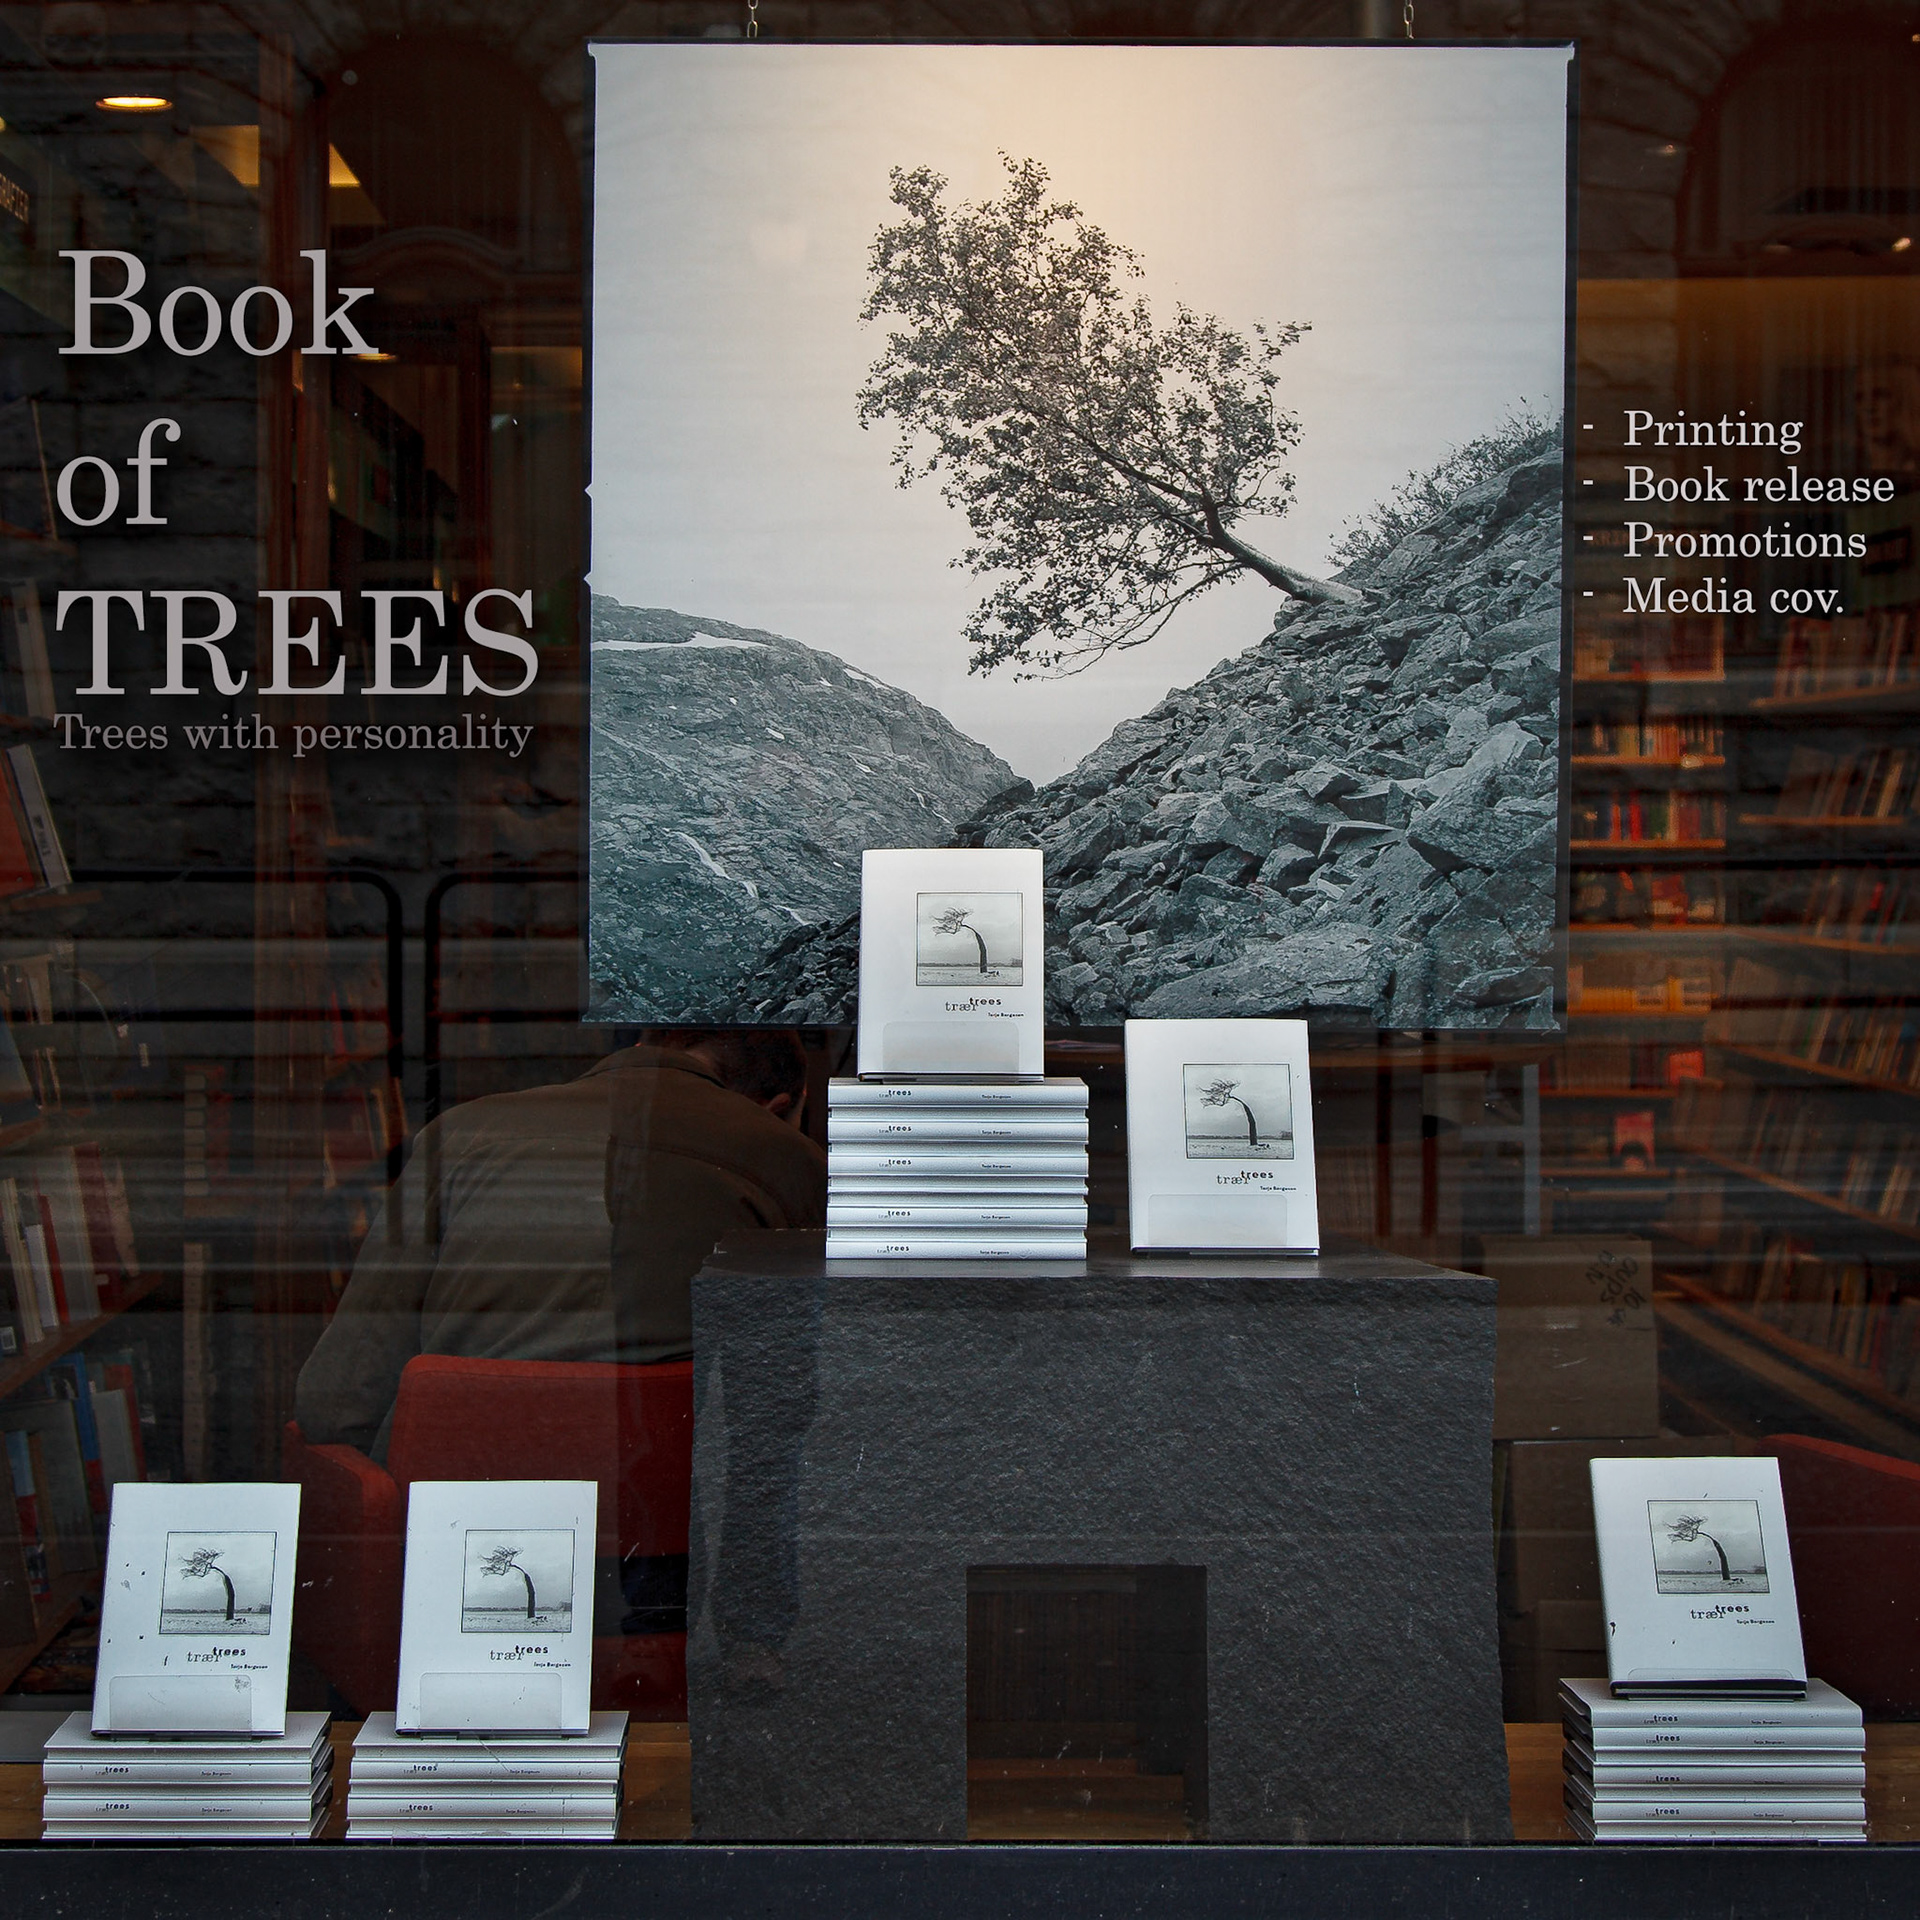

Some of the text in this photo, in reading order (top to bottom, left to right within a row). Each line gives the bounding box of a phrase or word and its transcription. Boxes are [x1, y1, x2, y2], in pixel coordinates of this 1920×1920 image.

[969, 997, 1002, 1007] trees
[888, 1089, 912, 1097] trees
[1241, 1170, 1274, 1180] trees
[1715, 1604, 1750, 1615] trees
[212, 1646, 247, 1657] trees
[515, 1645, 549, 1655] trees
[1654, 1714, 1679, 1722] trees
[1656, 1733, 1680, 1742] trees
[105, 1766, 129, 1774] trees
[413, 1764, 438, 1772] trees
[105, 1802, 130, 1811] trees
[409, 1803, 434, 1812] trees
[1655, 1807, 1680, 1816] trees
